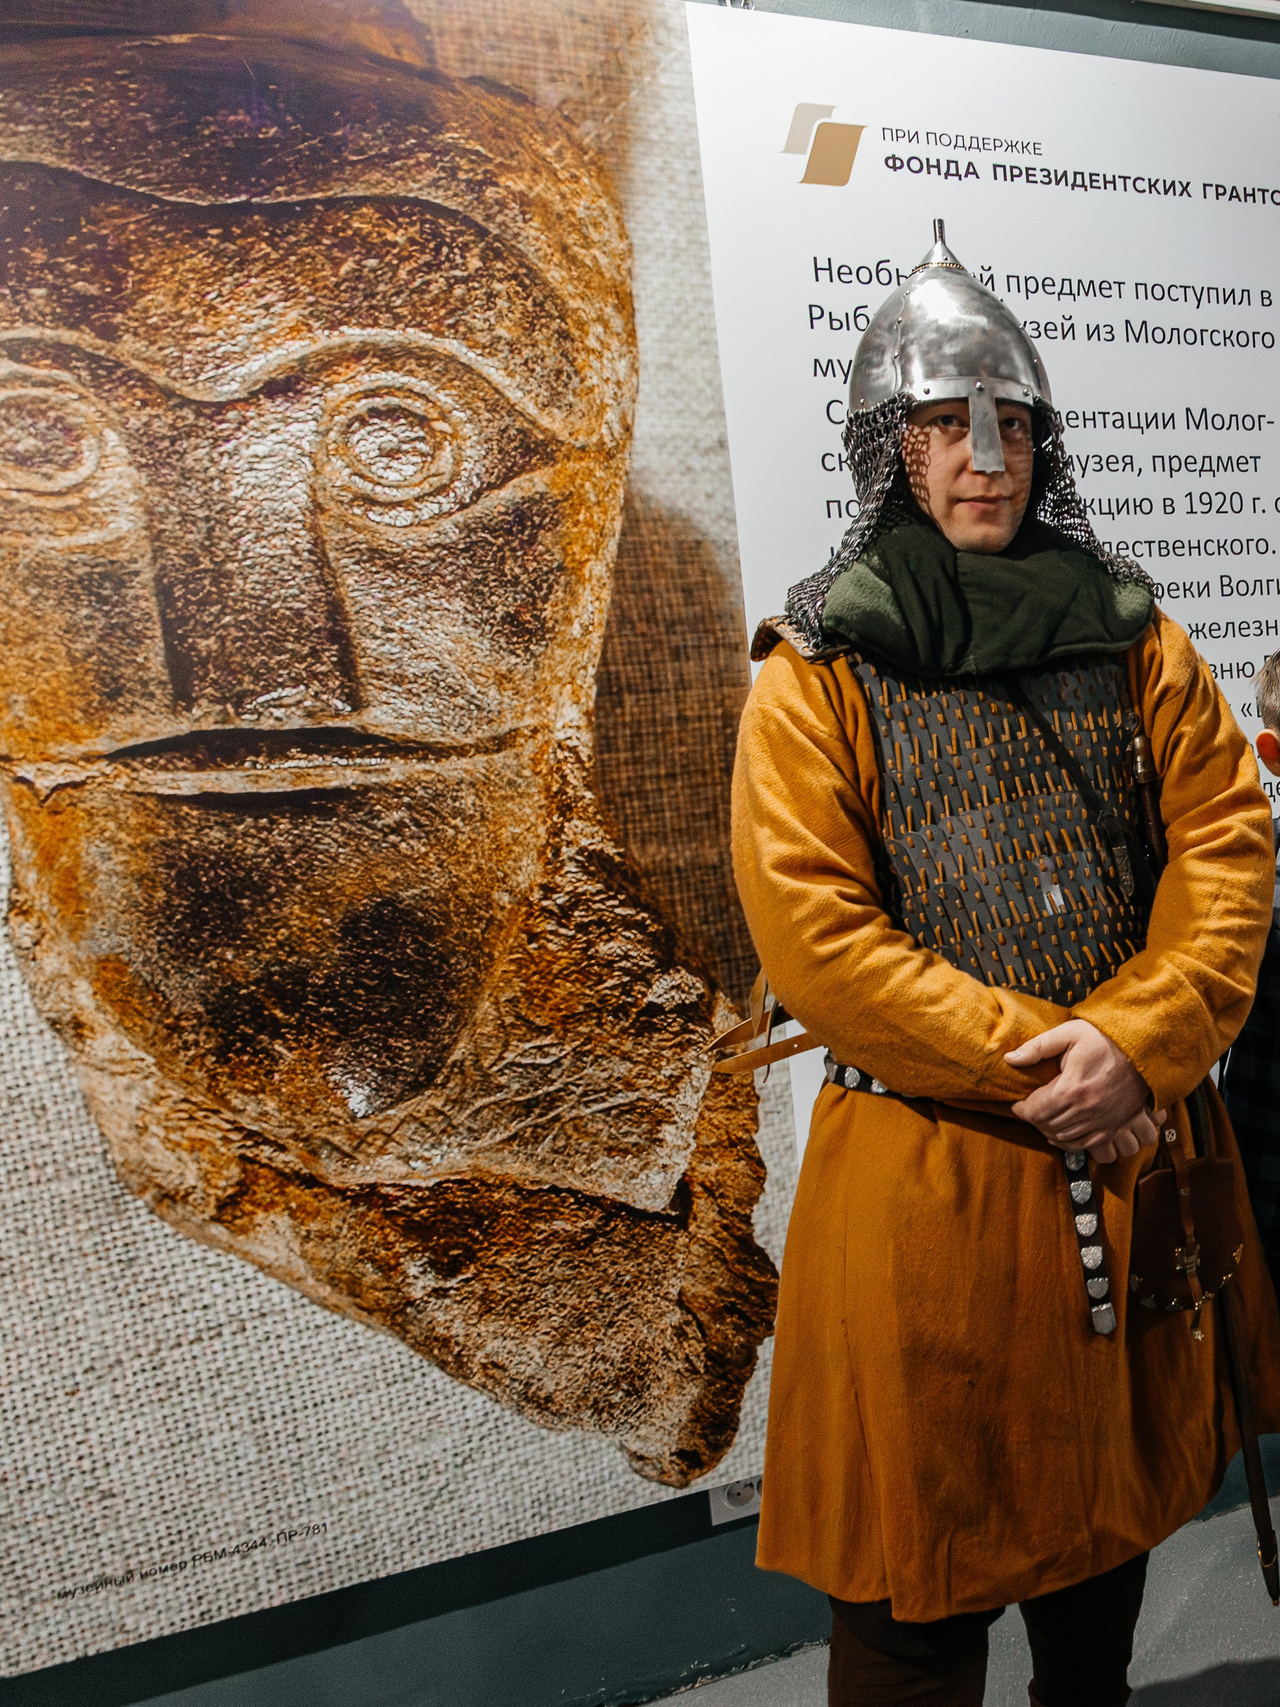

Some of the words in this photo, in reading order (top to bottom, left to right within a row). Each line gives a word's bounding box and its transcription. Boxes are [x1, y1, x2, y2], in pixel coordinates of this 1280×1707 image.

[881, 127, 920, 144] ПРИ
[925, 131, 1043, 156] ПОДДЕРЖКЕ
[884, 153, 981, 182] ФОНДА
[992, 163, 1193, 198] ПРЕЗИДЕНТСКИХ
[1006, 274, 1126, 302] предмет
[1134, 282, 1252, 310] поступил
[1260, 289, 1273, 308] в
[1086, 323, 1116, 342] из
[1124, 319, 1275, 349] Мологского
[1185, 407, 1275, 432] Молог-
[1151, 454, 1262, 479] предмет
[1162, 497, 1176, 515] в
[1184, 491, 1244, 515] 1920
[1252, 496, 1266, 514] г.
